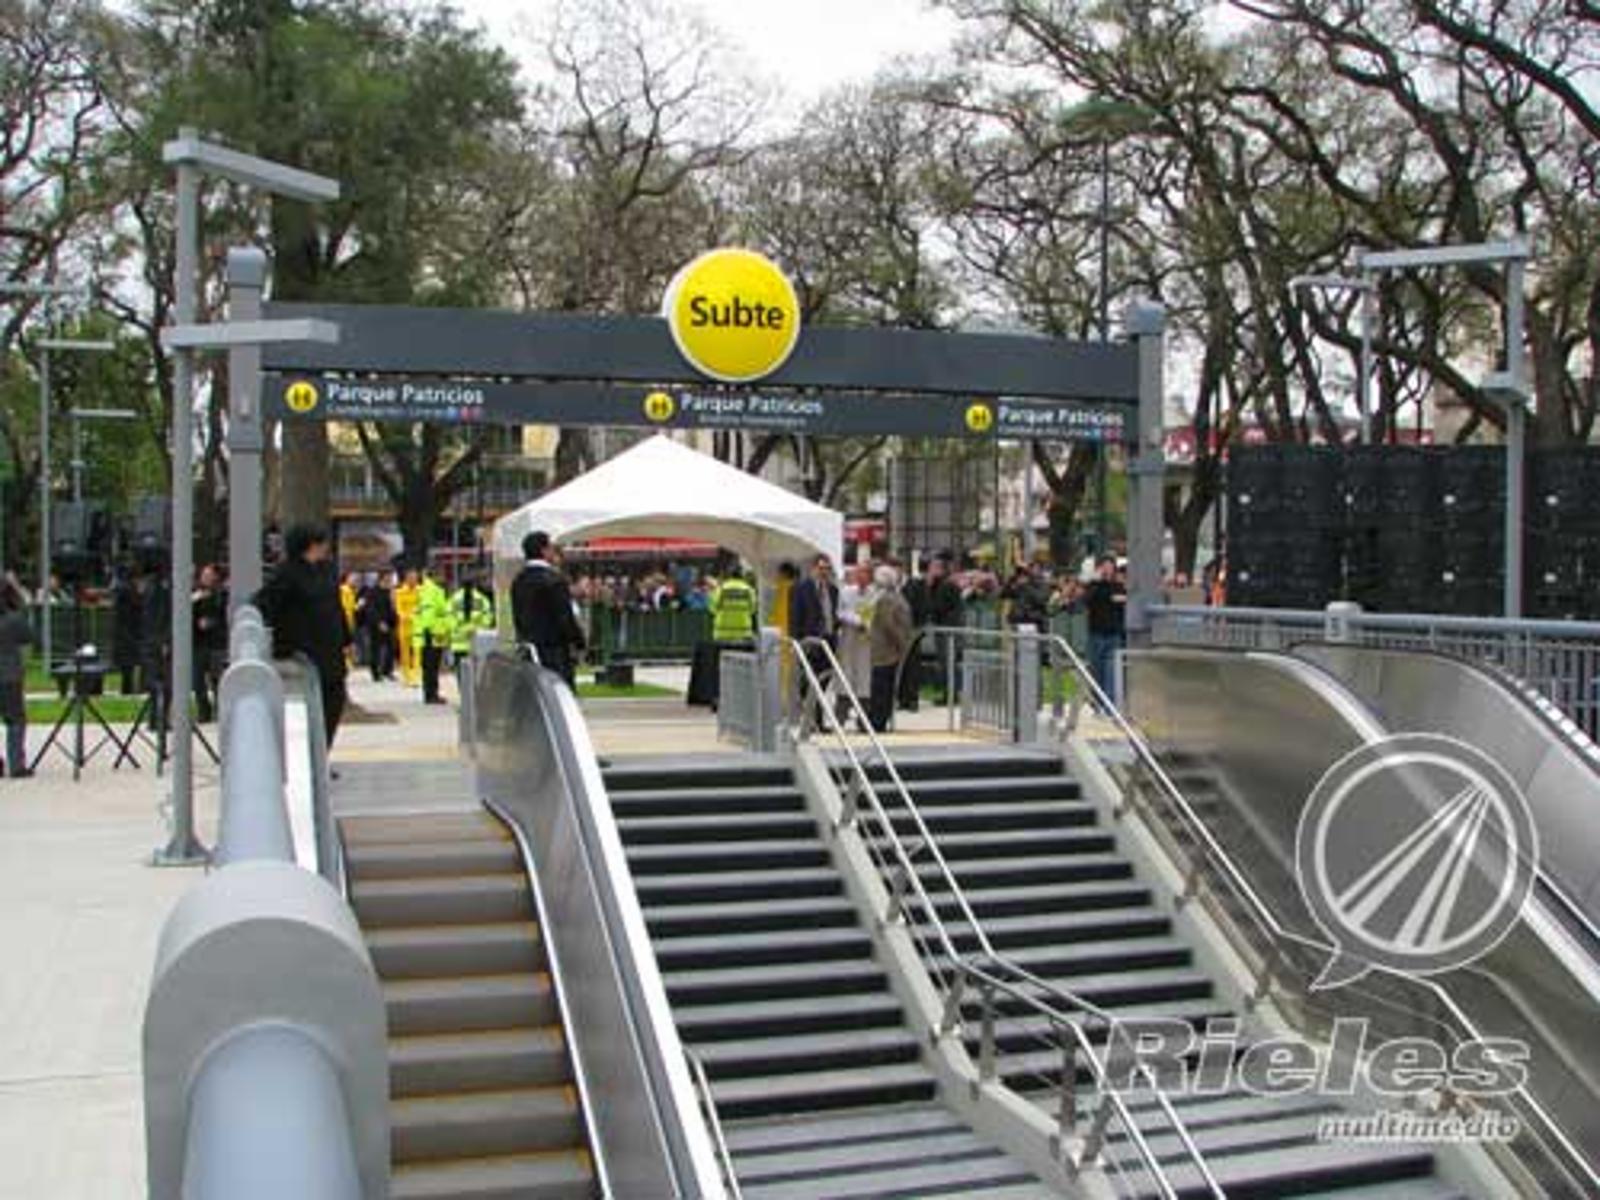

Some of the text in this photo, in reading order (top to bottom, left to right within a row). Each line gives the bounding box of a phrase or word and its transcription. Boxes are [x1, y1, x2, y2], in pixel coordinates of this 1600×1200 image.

[690, 296, 785, 329] Subte
[327, 384, 484, 405] Parque Patricios
[681, 393, 823, 415] Parque Patricios
[998, 405, 1125, 427] Parque Patricios
